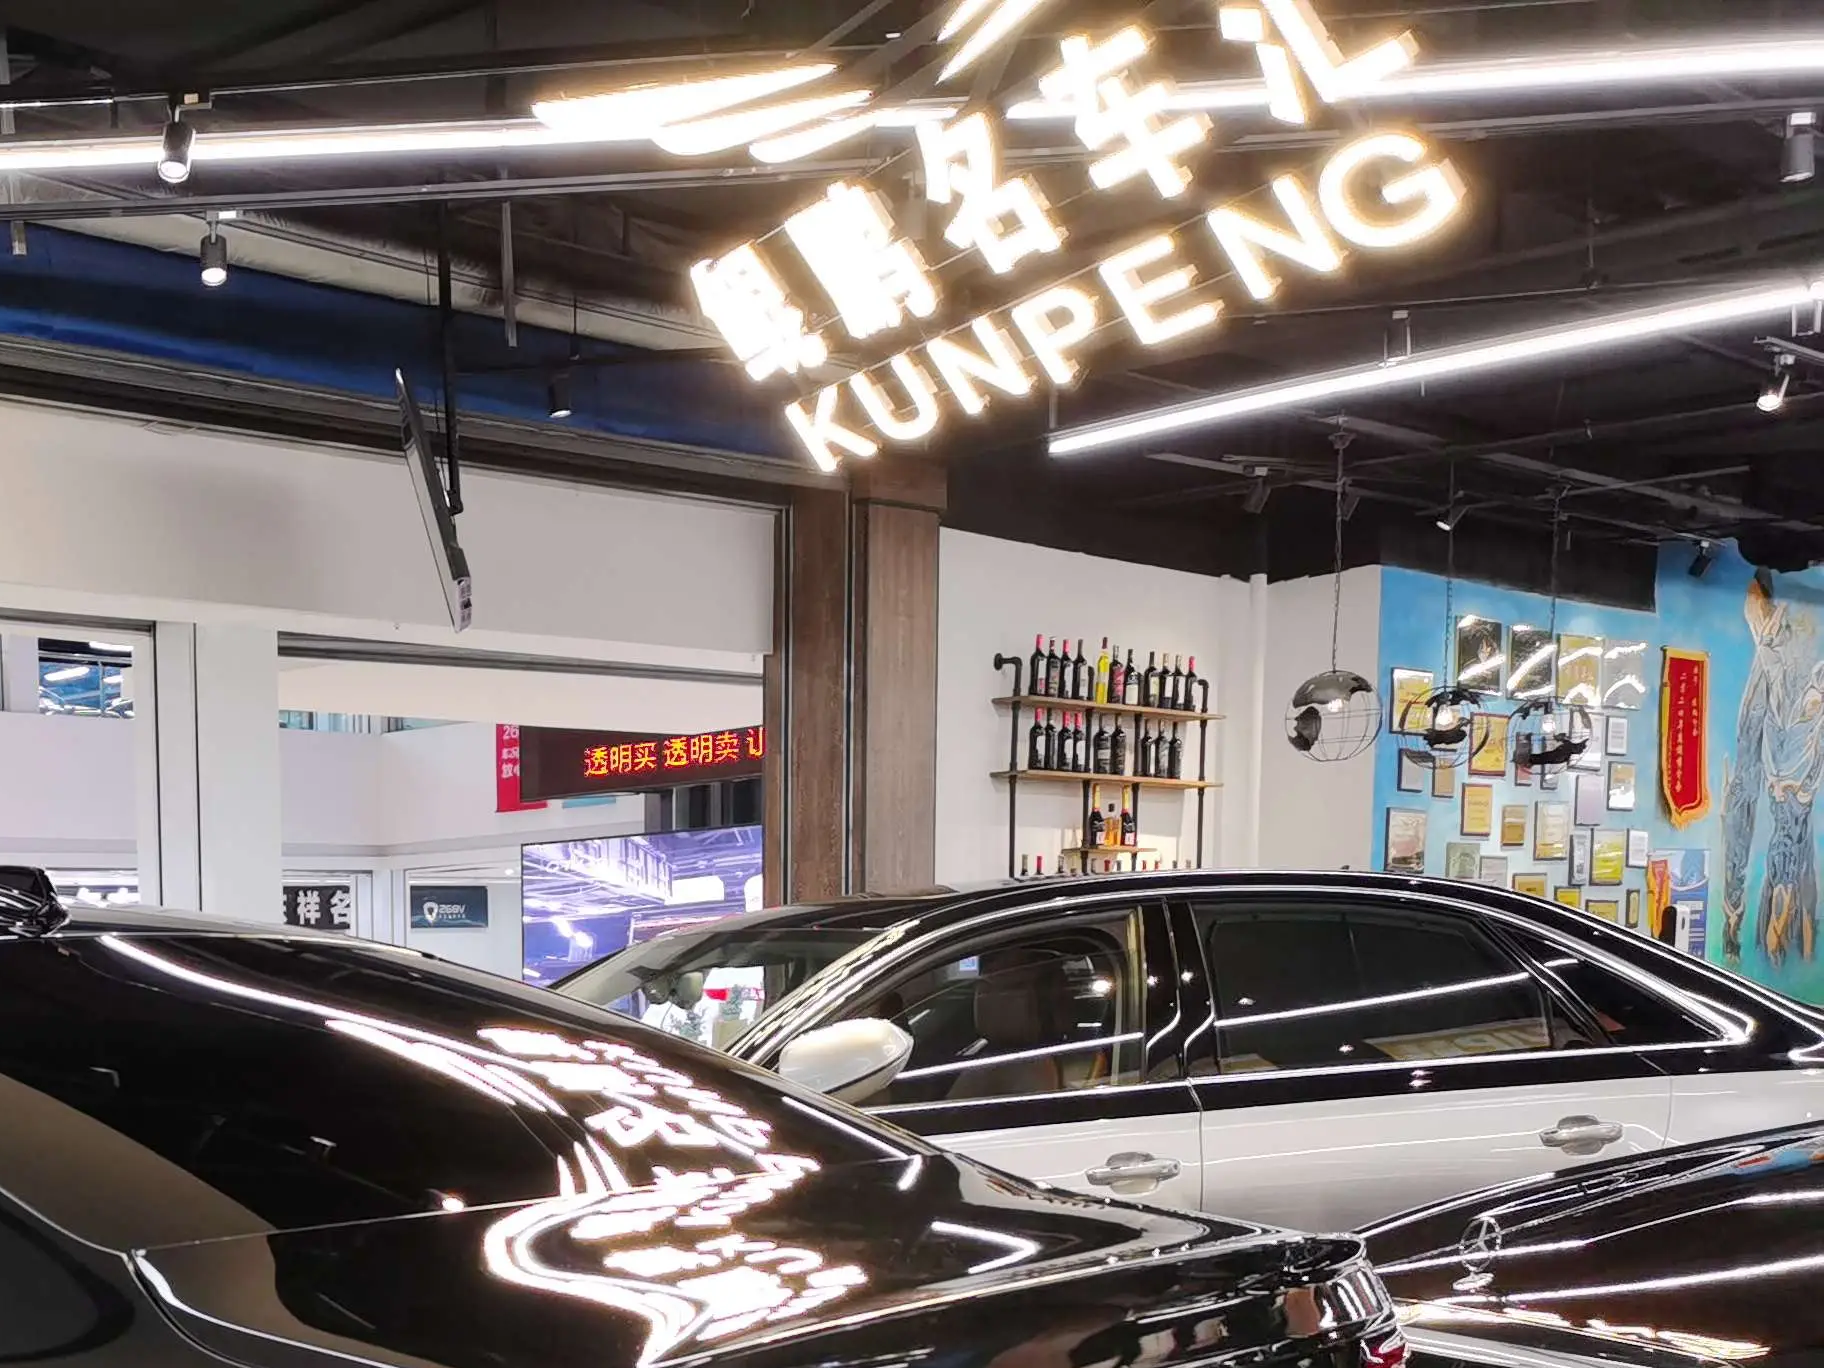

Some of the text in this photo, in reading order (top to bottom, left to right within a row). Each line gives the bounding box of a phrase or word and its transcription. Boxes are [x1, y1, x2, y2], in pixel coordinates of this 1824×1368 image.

[784, 132, 1460, 473] KUNPENG
[584, 742, 657, 777] 透明买
[663, 733, 739, 768] 透明卖
[283, 889, 351, 926] 祥名
